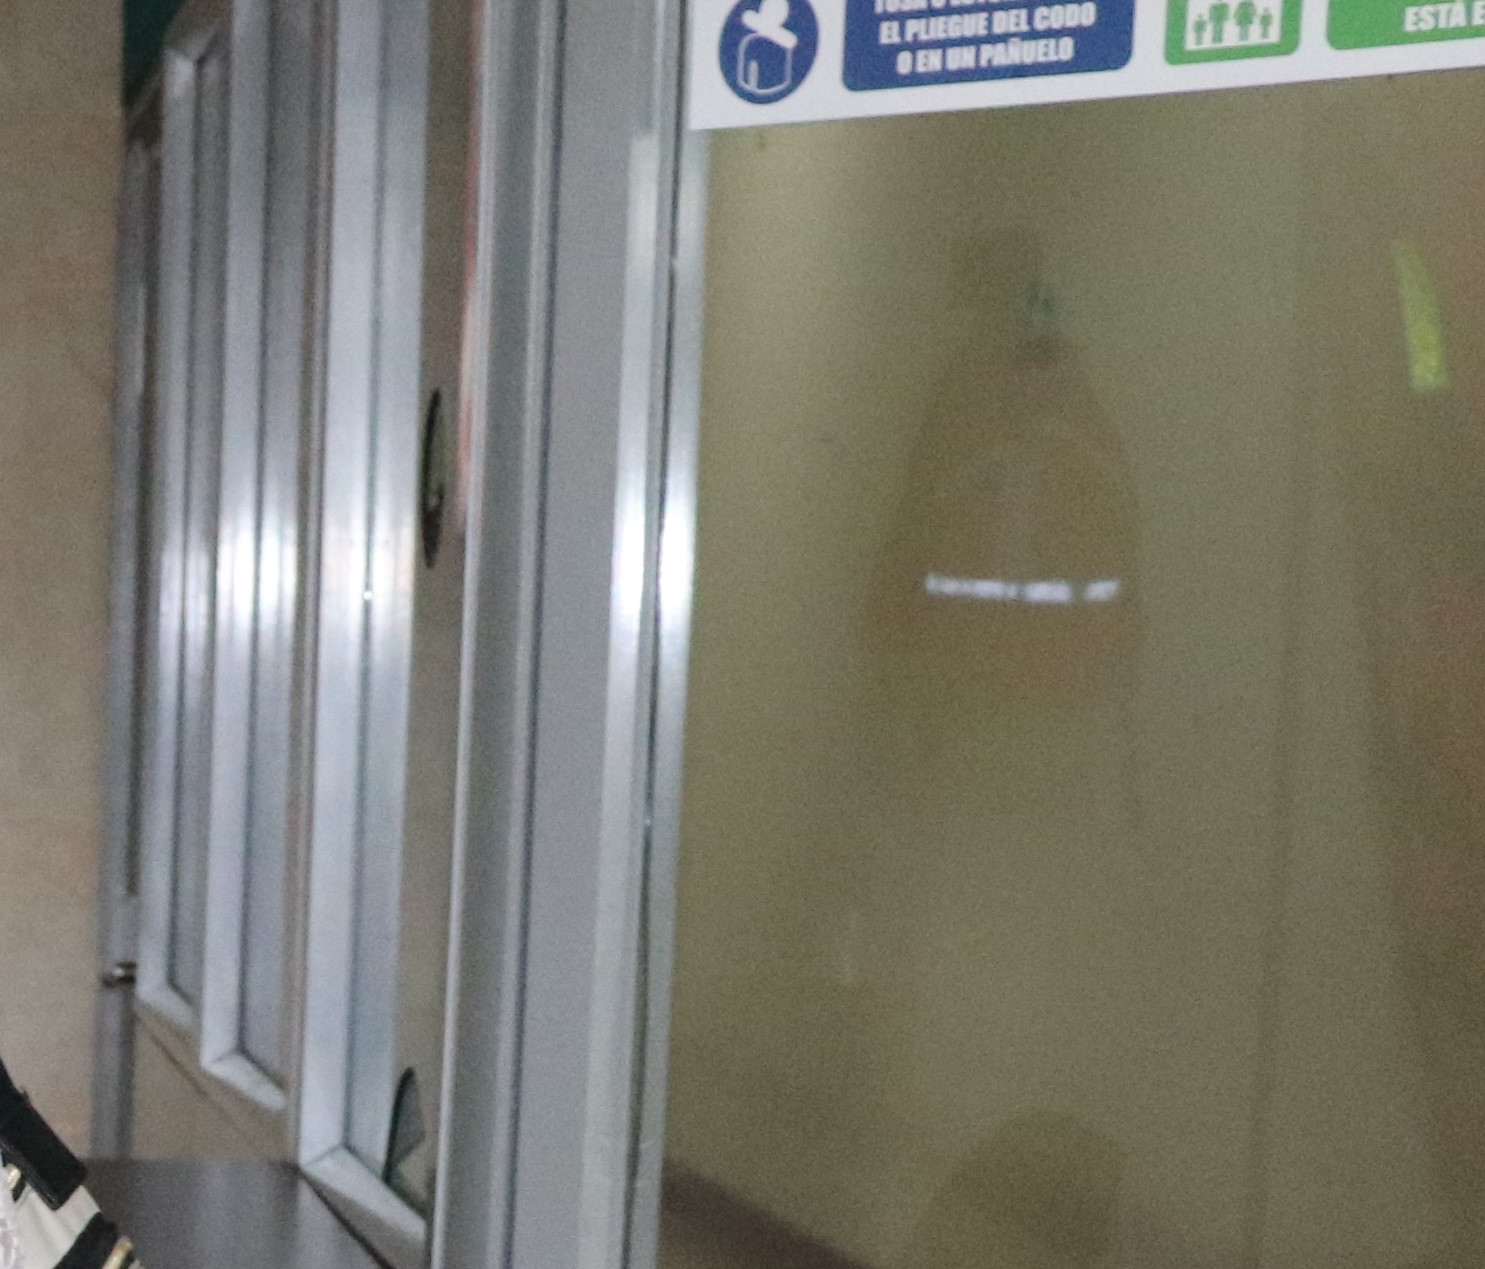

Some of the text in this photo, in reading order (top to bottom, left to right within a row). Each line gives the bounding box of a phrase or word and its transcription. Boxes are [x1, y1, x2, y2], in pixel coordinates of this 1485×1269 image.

[879, 2, 1097, 45] EL PLIEGUE DEL CODO
[914, 48, 943, 73] EN
[945, 45, 976, 71] UN
[978, 37, 1075, 68] PAÑUELO
